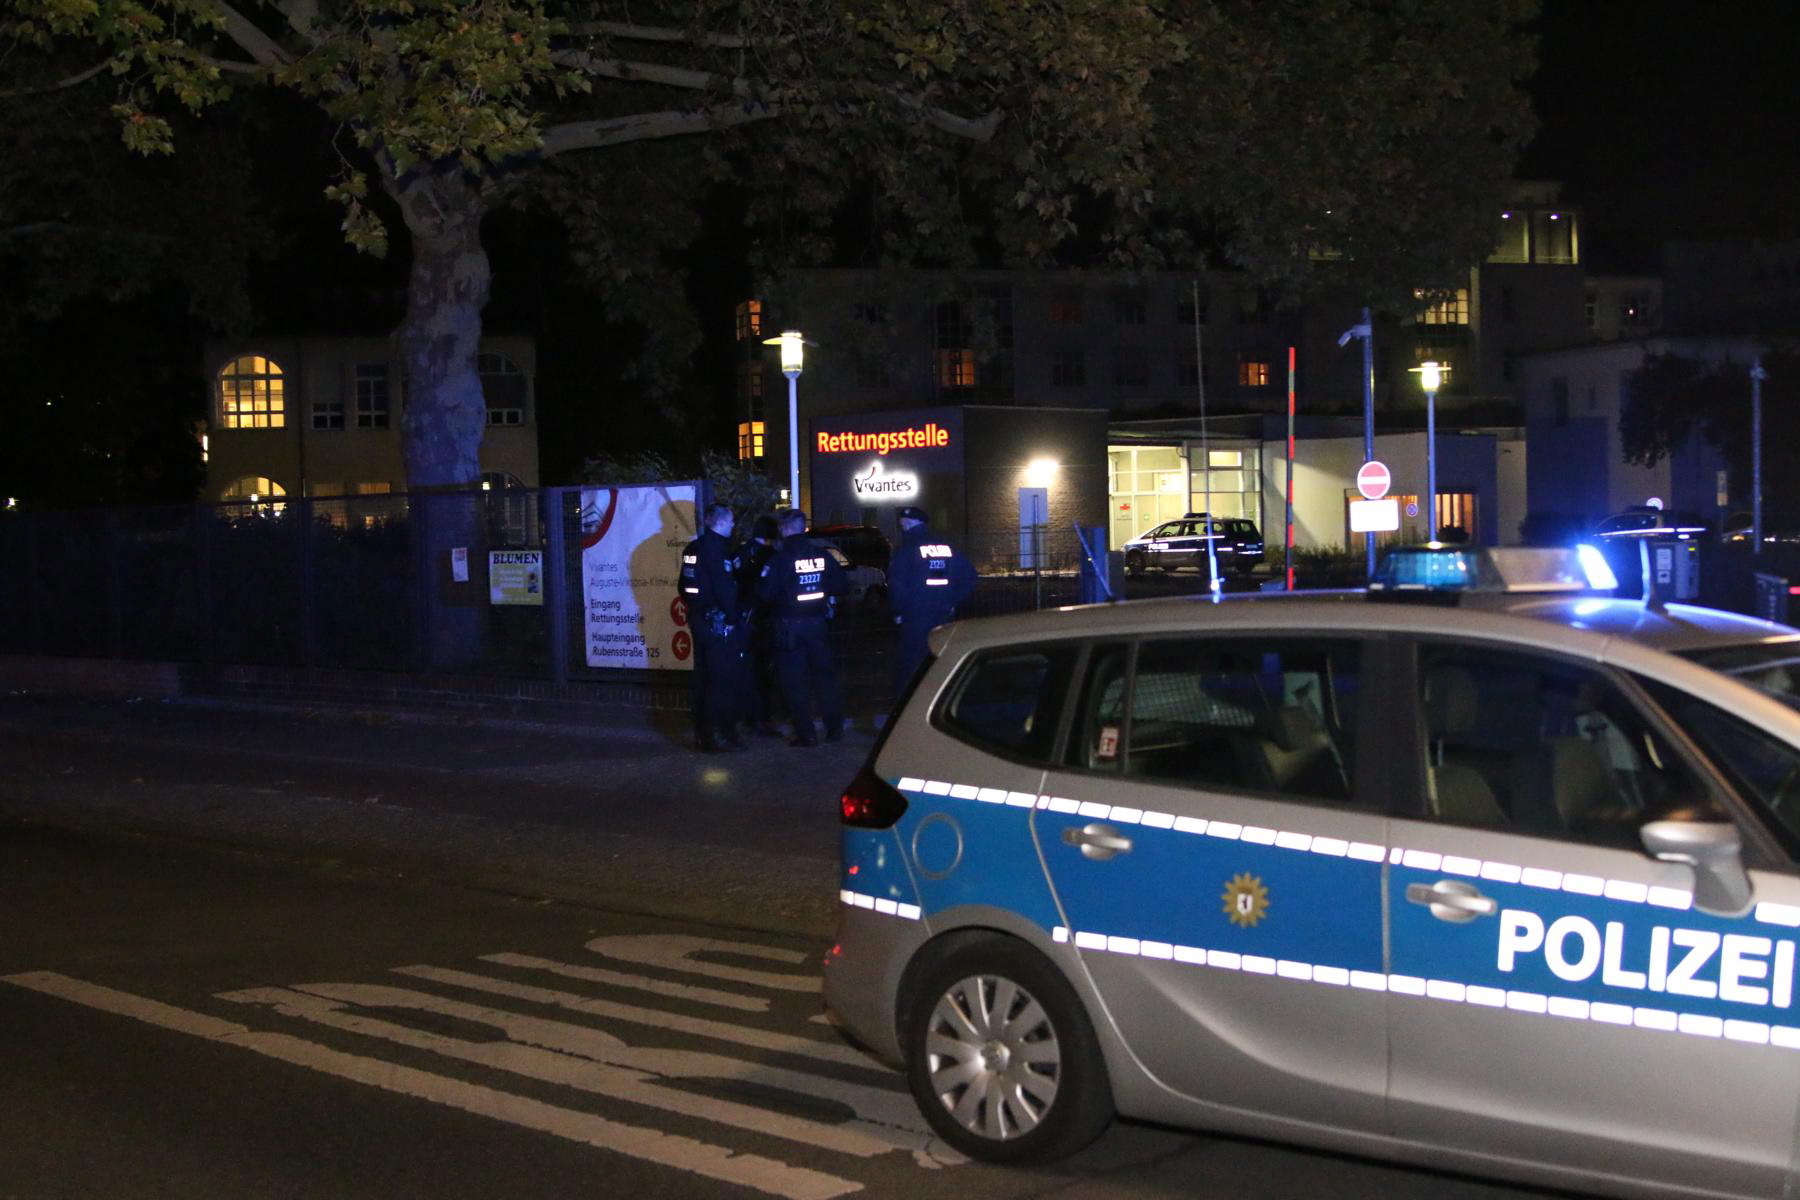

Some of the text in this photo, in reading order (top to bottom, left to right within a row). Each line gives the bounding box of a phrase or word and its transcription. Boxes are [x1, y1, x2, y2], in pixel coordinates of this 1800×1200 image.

[817, 423, 949, 455] Rettungsstelle
[854, 474, 912, 493] Vivantes
[493, 552, 540, 565] BLUMEN
[590, 599, 621, 612] Eingang
[591, 613, 645, 626] Rettungsstelle
[592, 632, 645, 646] Haupteingang
[592, 646, 660, 658] Rubensstraße 125
[1497, 908, 1796, 1009] POLIZEI
